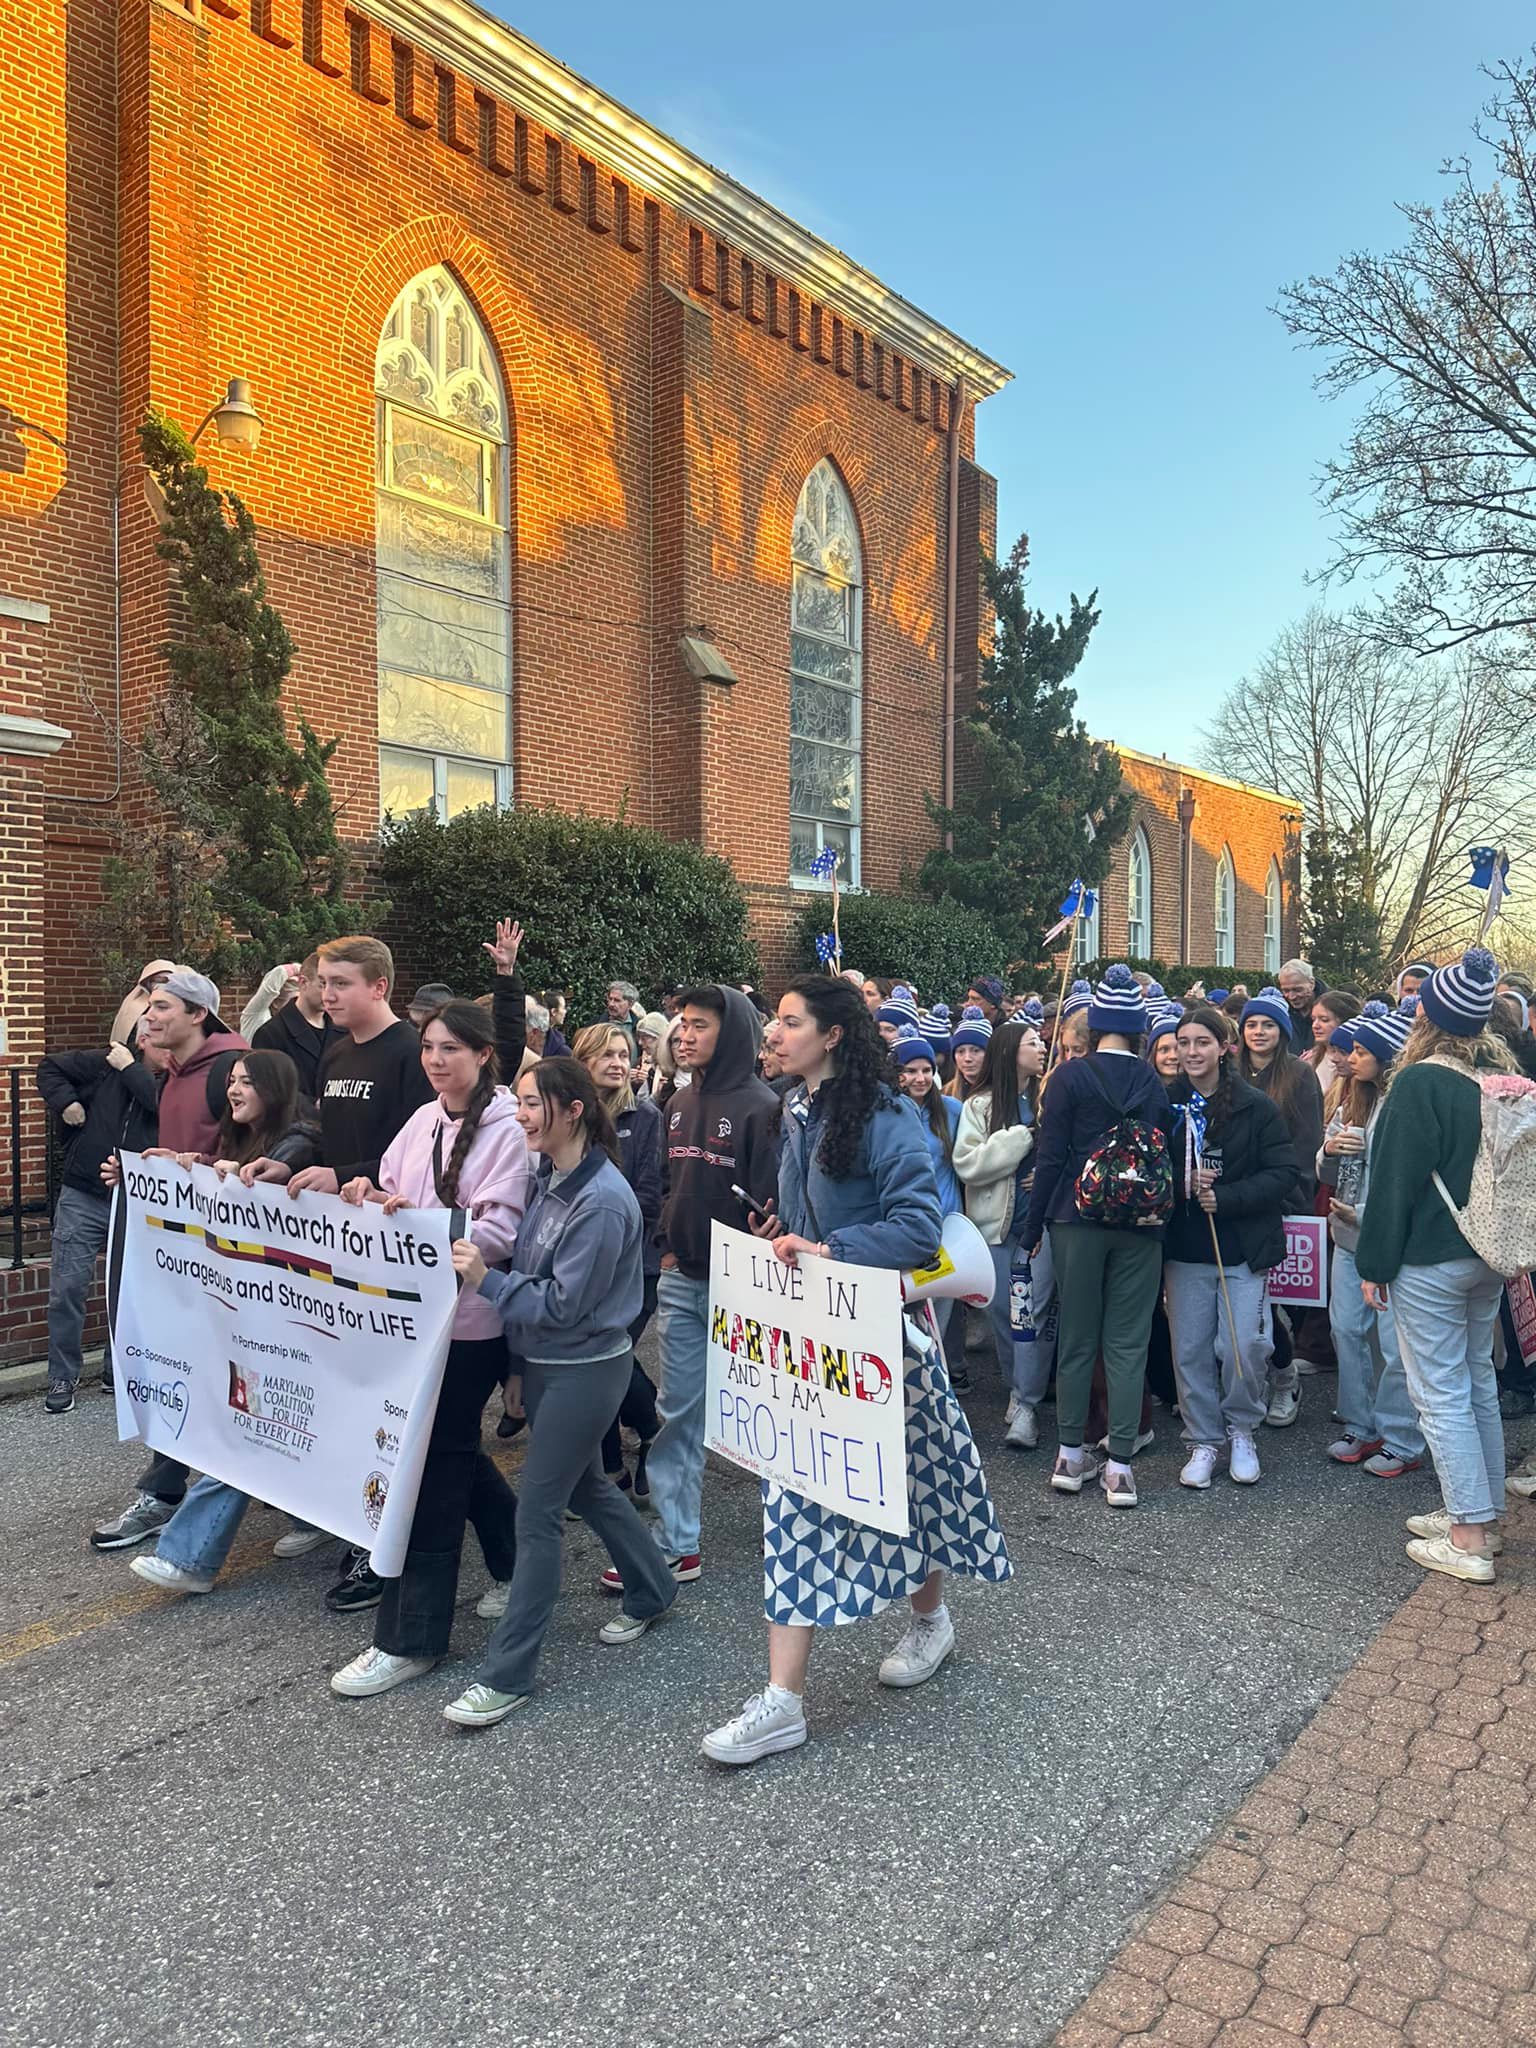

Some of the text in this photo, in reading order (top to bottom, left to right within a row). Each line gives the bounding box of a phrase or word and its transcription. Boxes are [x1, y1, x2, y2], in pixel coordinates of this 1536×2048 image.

[349, 1079, 374, 1100] LIFE
[127, 1171, 438, 1268] 2025 Maryland March for Life
[155, 1248, 417, 1341] Courageous and Strong for LIFE
[722, 1243, 858, 1321] I LIVE IN
[126, 1345, 182, 1371] Co-Sponsored
[238, 1335, 289, 1360] Partnership
[289, 1347, 313, 1365] With:
[711, 1304, 893, 1405] MARYLAND
[263, 1375, 315, 1401] MARYLAND
[264, 1390, 315, 1417] COALITION
[728, 1356, 826, 1419] AND I AM
[233, 1412, 253, 1431] FOR
[255, 1420, 291, 1442] EVERY
[291, 1432, 314, 1453] LIFE
[272, 1407, 310, 1431] FOR LIFE
[719, 1389, 886, 1507] PRO-LIFE!
